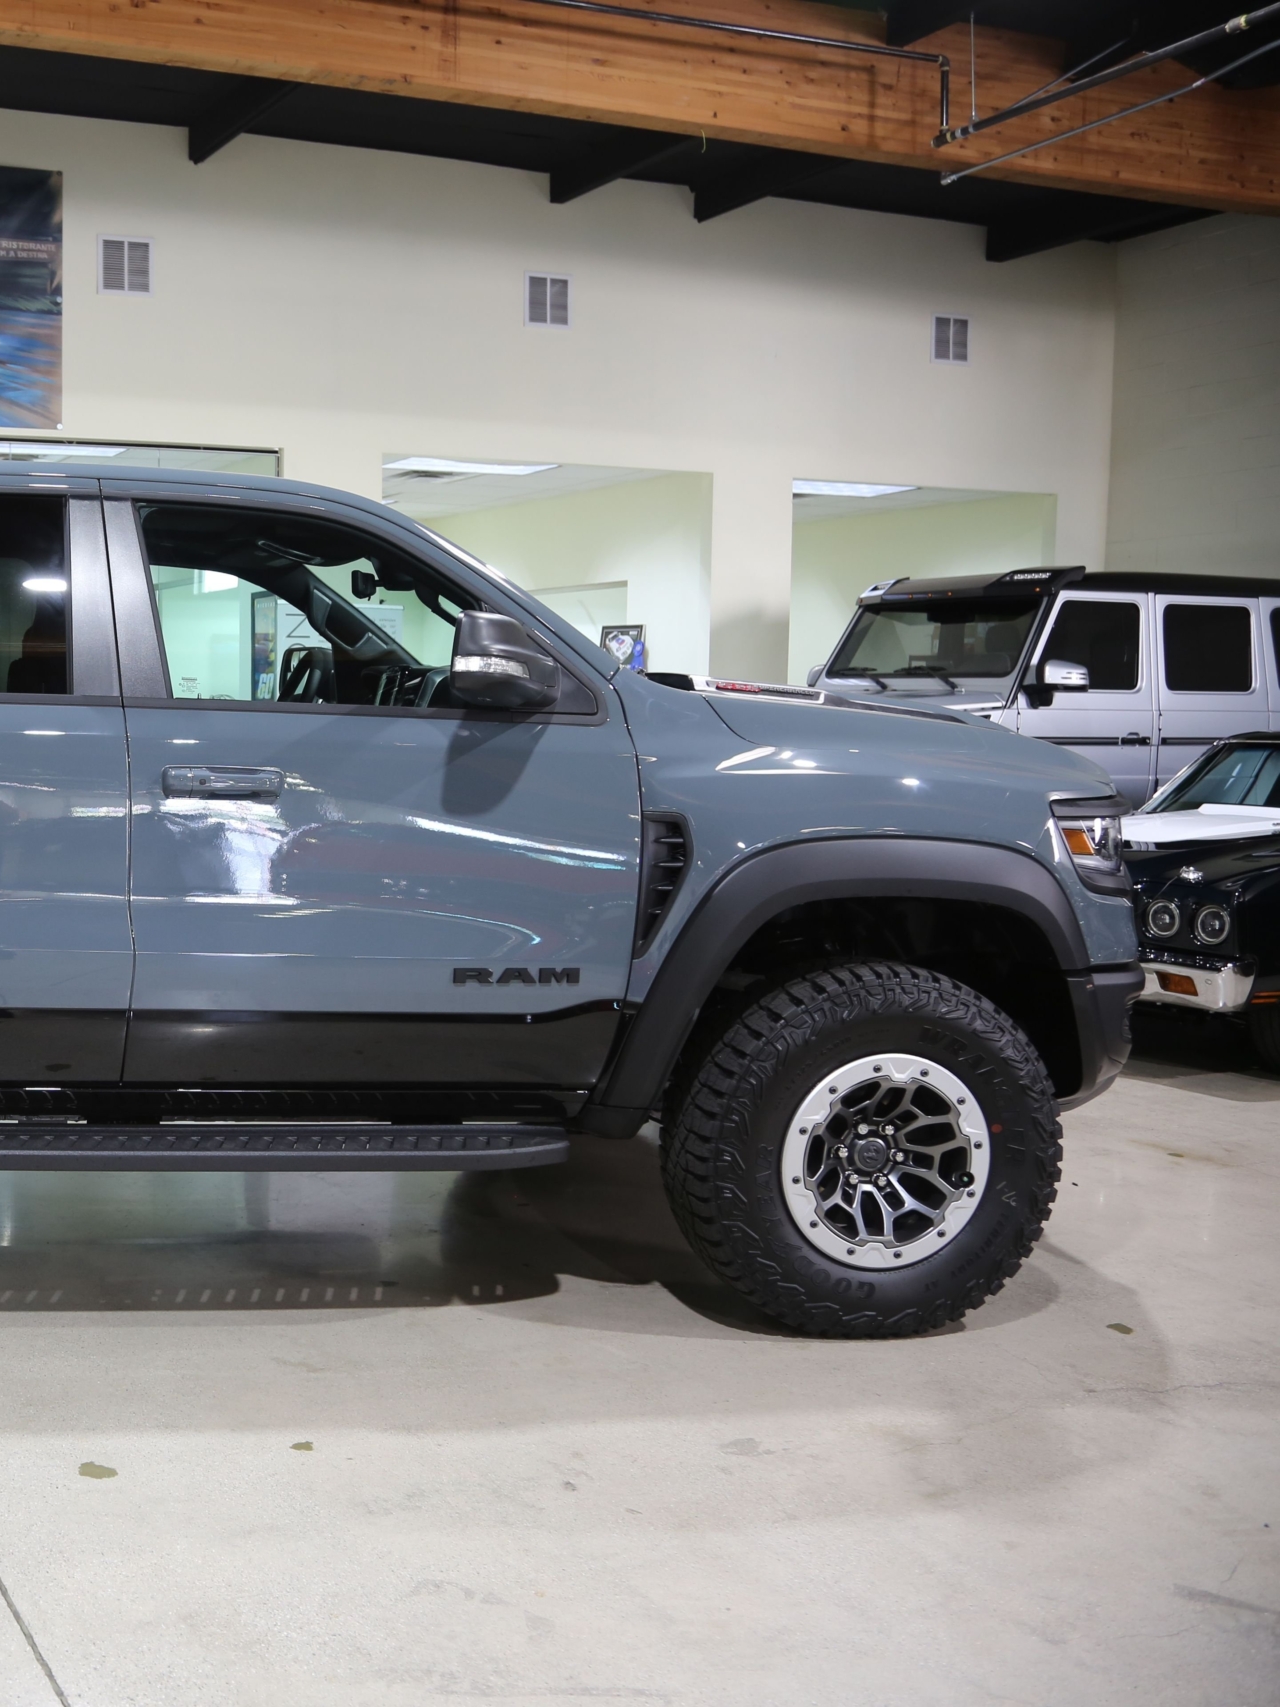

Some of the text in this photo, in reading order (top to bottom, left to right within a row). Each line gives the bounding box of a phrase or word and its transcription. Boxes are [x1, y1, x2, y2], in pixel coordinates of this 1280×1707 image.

[0, 239, 56, 251] RISTORANTE
[257, 673, 274, 699] 60
[453, 967, 581, 984] RAM
